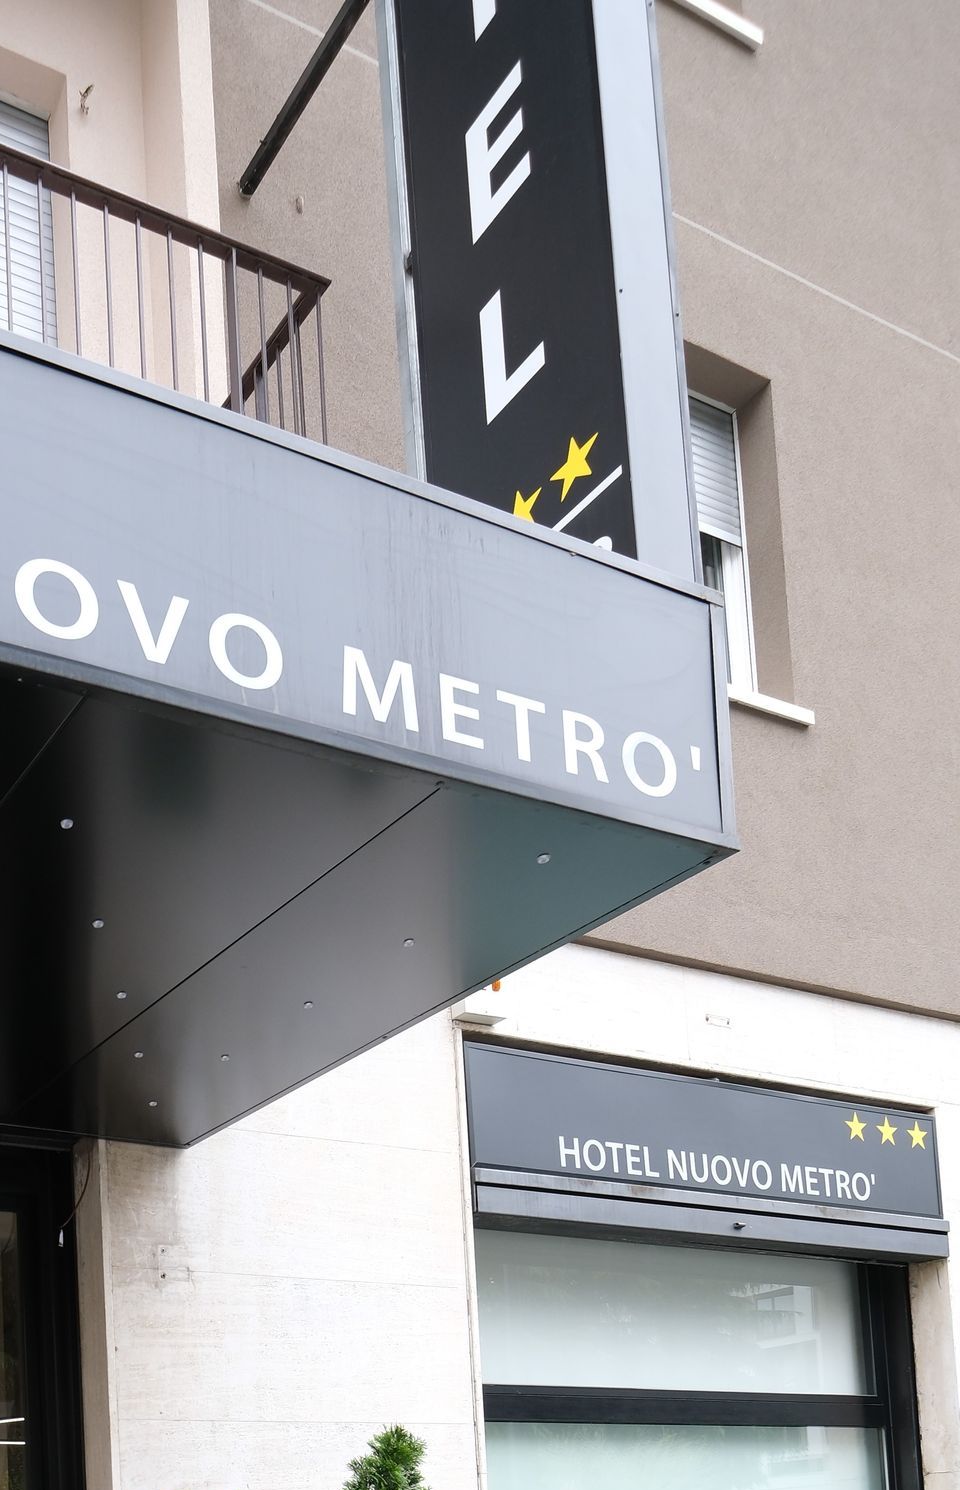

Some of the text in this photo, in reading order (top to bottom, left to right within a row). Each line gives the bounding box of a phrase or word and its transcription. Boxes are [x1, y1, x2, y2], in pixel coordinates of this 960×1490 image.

[342, 645, 702, 798] METRO'
[558, 1135, 876, 1202] HOTEL NUOVO METRO'
